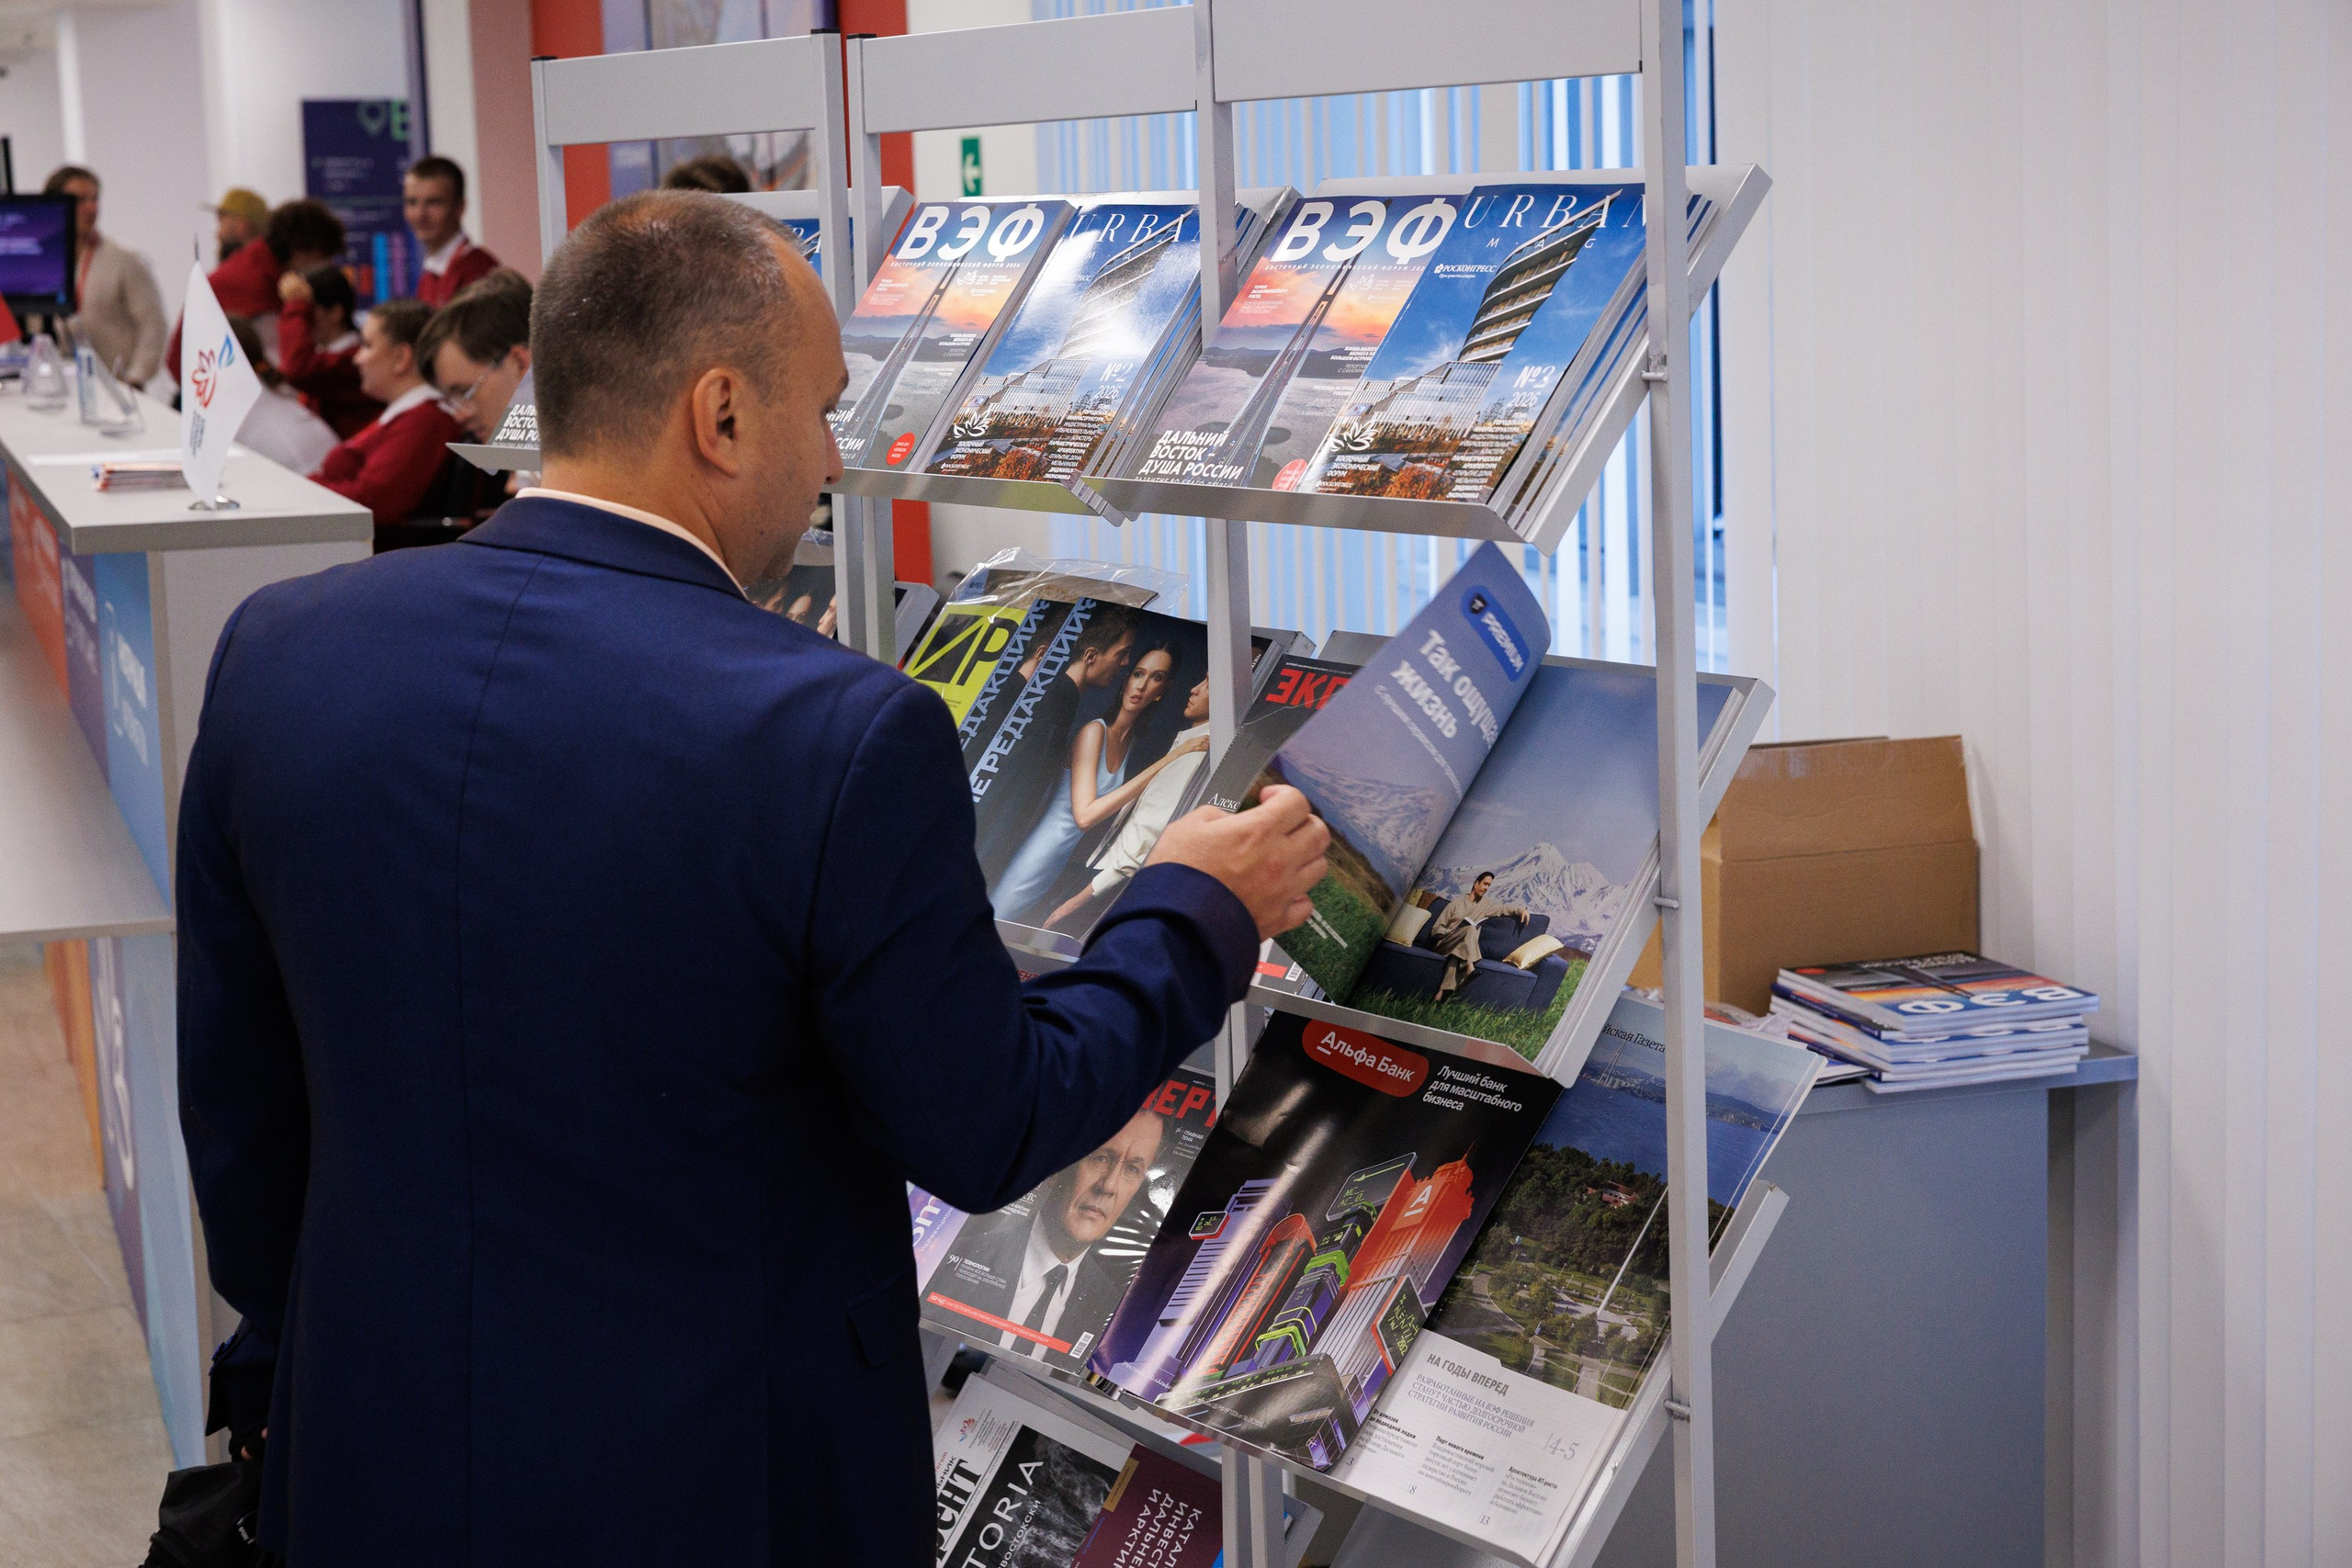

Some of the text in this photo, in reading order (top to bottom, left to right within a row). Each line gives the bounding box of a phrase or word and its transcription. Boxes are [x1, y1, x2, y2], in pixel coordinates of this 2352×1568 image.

[896, 203, 1045, 260] ВЭФ
[1069, 213, 1200, 243] URBA
[1271, 198, 1457, 264] ВЭФ
[1442, 264, 1498, 273] РОСКОНГРЕСС
[1094, 386, 1122, 399] 2026
[1507, 391, 1542, 407] 2026
[508, 404, 537, 416] ДАЛЬ
[495, 428, 524, 441] ДУША
[1157, 430, 1229, 446] ДАЛЬНИЙ
[1149, 446, 1207, 461] ВОСТОК
[1138, 460, 1244, 480] ДУША РОССИИ
[1419, 628, 1462, 682] Так
[1390, 660, 1458, 739] жизнь
[1602, 1023, 1666, 1054] йская Газета
[1320, 1031, 1416, 1083] Альфа Банк
[1437, 1066, 1509, 1093] Лучший банк
[1422, 1091, 1465, 1111] бизнеса
[1429, 1079, 1522, 1113] для масштабного
[922, 1206, 955, 1252] ПЕРФЕКЦИОН
[947, 1254, 960, 1265] 90
[1427, 1353, 1510, 1397] НА ГОДЫ ВПЕРЕД
[1412, 1382, 1526, 1434] СТАНУТ ЧАСТЬЮ ДОЛГОСРОЧНОЙ
[1416, 1373, 1535, 1428] РАЗРАБОТАННЫЕ НА ВЭФ РЕШЕНИЯ
[1375, 1419, 1402, 1433] подводной
[1408, 1390, 1512, 1438] СТРАТЕГИИ РАЗВИТИЯ РОССИИ
[1435, 1436, 1485, 1461] Порт нового времени
[1549, 1437, 1580, 1461] 4-5
[1347, 1457, 1354, 1467] 3
[1509, 1466, 1538, 1482] Архитектура
[1148, 1488, 1162, 1503] И
[1409, 1484, 1417, 1495] 8
[1128, 1494, 1174, 1568] ДАЛЬНЕ
[1480, 1515, 1491, 1526] 13
[1148, 1502, 1189, 1568] ИНВЕСТ
[1165, 1507, 1203, 1568] КАТАЛ
